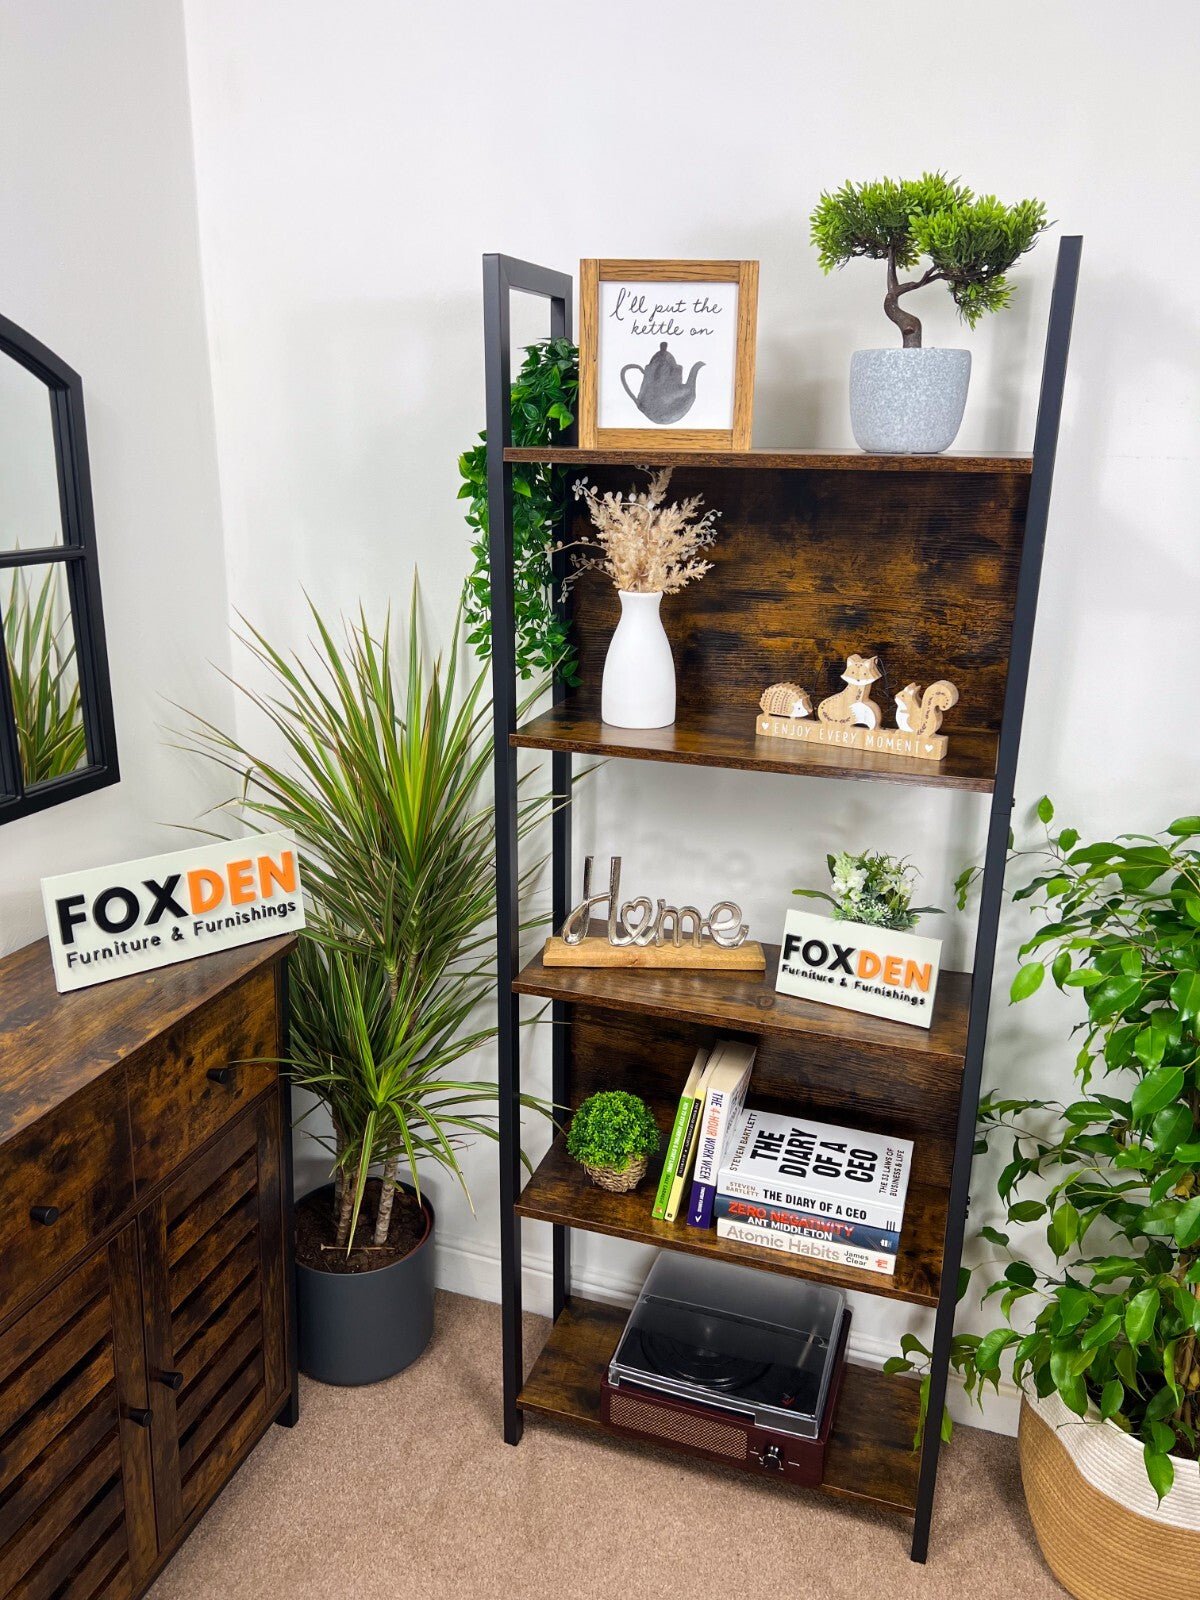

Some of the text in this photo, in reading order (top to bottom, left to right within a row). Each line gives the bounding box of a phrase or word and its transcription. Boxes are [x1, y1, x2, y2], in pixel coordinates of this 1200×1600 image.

[609, 287, 722, 322] I'll put the
[631, 319, 714, 336] kettle on
[774, 722, 920, 754] ENJOY EVERY MOMENT
[55, 850, 297, 945] FOXDEN
[66, 901, 296, 969] Furniture & Furnishings
[783, 933, 932, 993] FOXDEN
[781, 964, 926, 1006] Furniture & Furnishings
[711, 1093, 723, 1108] THE
[706, 1107, 720, 1137] 4-HOUR
[703, 1137, 716, 1160] WORK
[730, 1143, 745, 1171] STEVEN
[740, 1113, 757, 1145] BARTLETT
[750, 1129, 785, 1161] THE
[778, 1127, 817, 1178] DIARY
[886, 1148, 894, 1156] OF
[699, 1160, 712, 1180] WEEK
[812, 1141, 847, 1178] OF A
[845, 1148, 878, 1183] CEO
[884, 1157, 892, 1173] LAWS
[890, 1167, 901, 1197] BUSINESS
[896, 1149, 905, 1162] LIFE
[726, 1186, 759, 1197] BARTLETT
[730, 1181, 756, 1191] STEVEN
[879, 1181, 888, 1194] THE
[728, 1201, 855, 1237] ZERO NEGATIVITY
[763, 1189, 867, 1220] THE DIARY OF A CEO
[726, 1225, 840, 1261] Atomic Habits
[747, 1216, 833, 1242] ANT MIDDLETON
[843, 1250, 869, 1262] James
[845, 1257, 867, 1267] Clear
